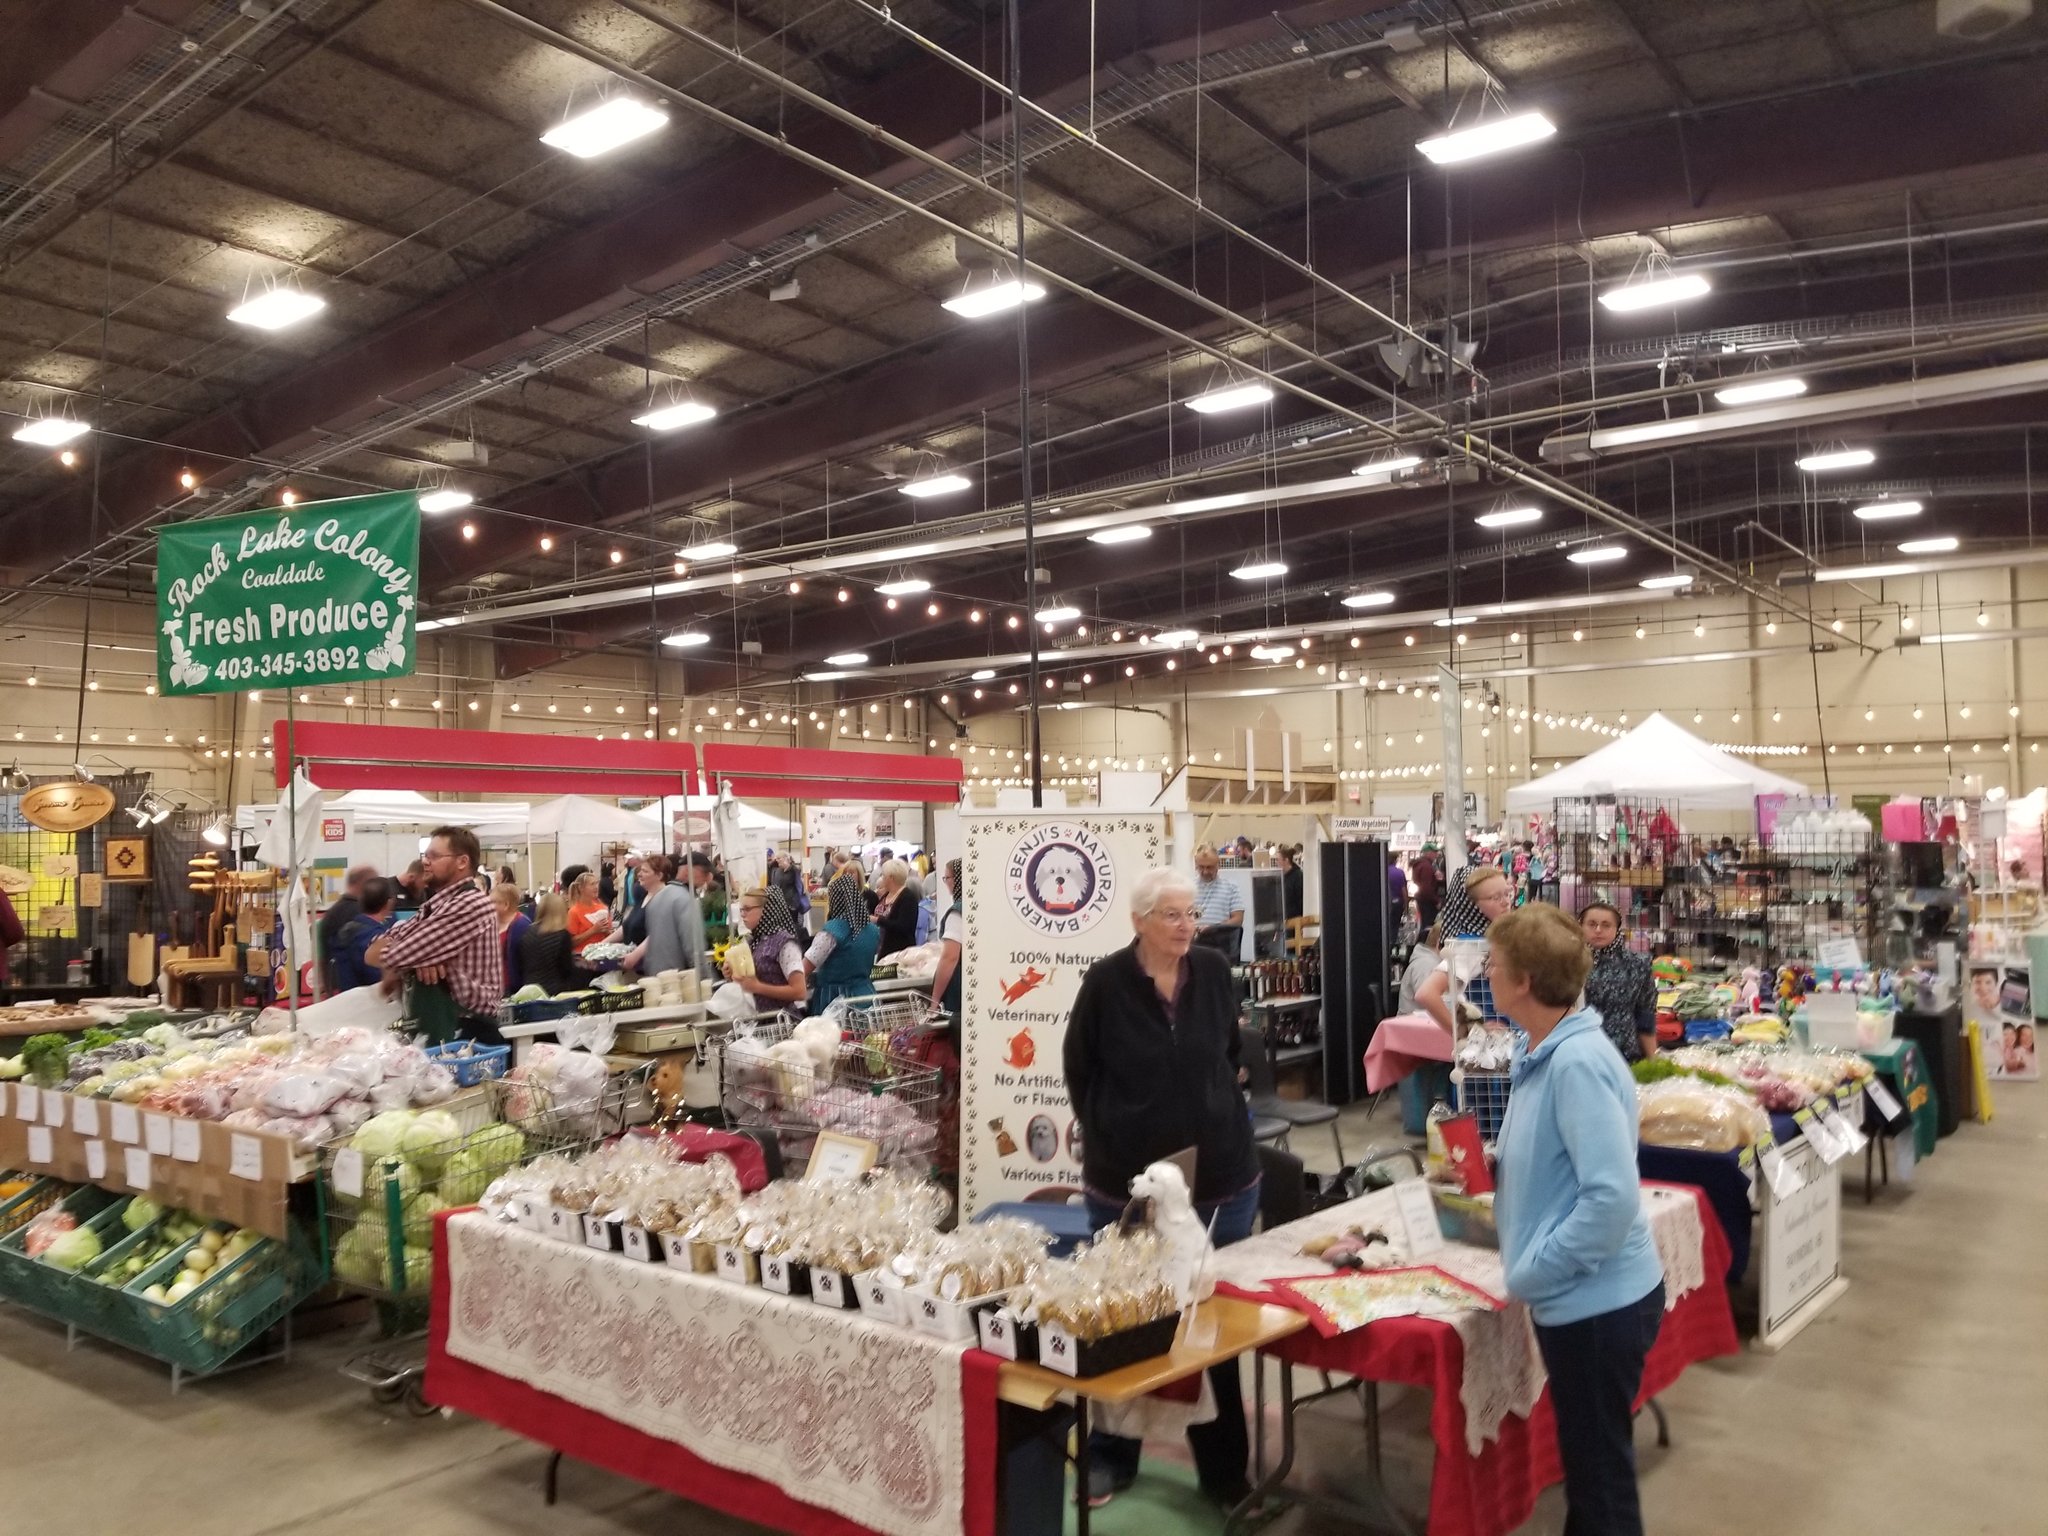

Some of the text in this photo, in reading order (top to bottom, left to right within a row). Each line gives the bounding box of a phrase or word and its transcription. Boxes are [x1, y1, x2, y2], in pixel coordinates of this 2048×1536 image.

[168, 516, 412, 618] Rock Lake Colony
[241, 560, 326, 590] Coaldale
[188, 598, 389, 647] Fresh Produce
[214, 646, 360, 681] 403-345-3892
[1361, 819, 1388, 830] Vegetables
[1010, 826, 1112, 933] BENJI'S NATURAL BAKERY
[1009, 951, 1051, 965] 100%
[988, 1008, 1060, 1025] Veterinary
[994, 1073, 1014, 1087] No
[1013, 1094, 1027, 1104] or
[1001, 1168, 1054, 1183] Various
